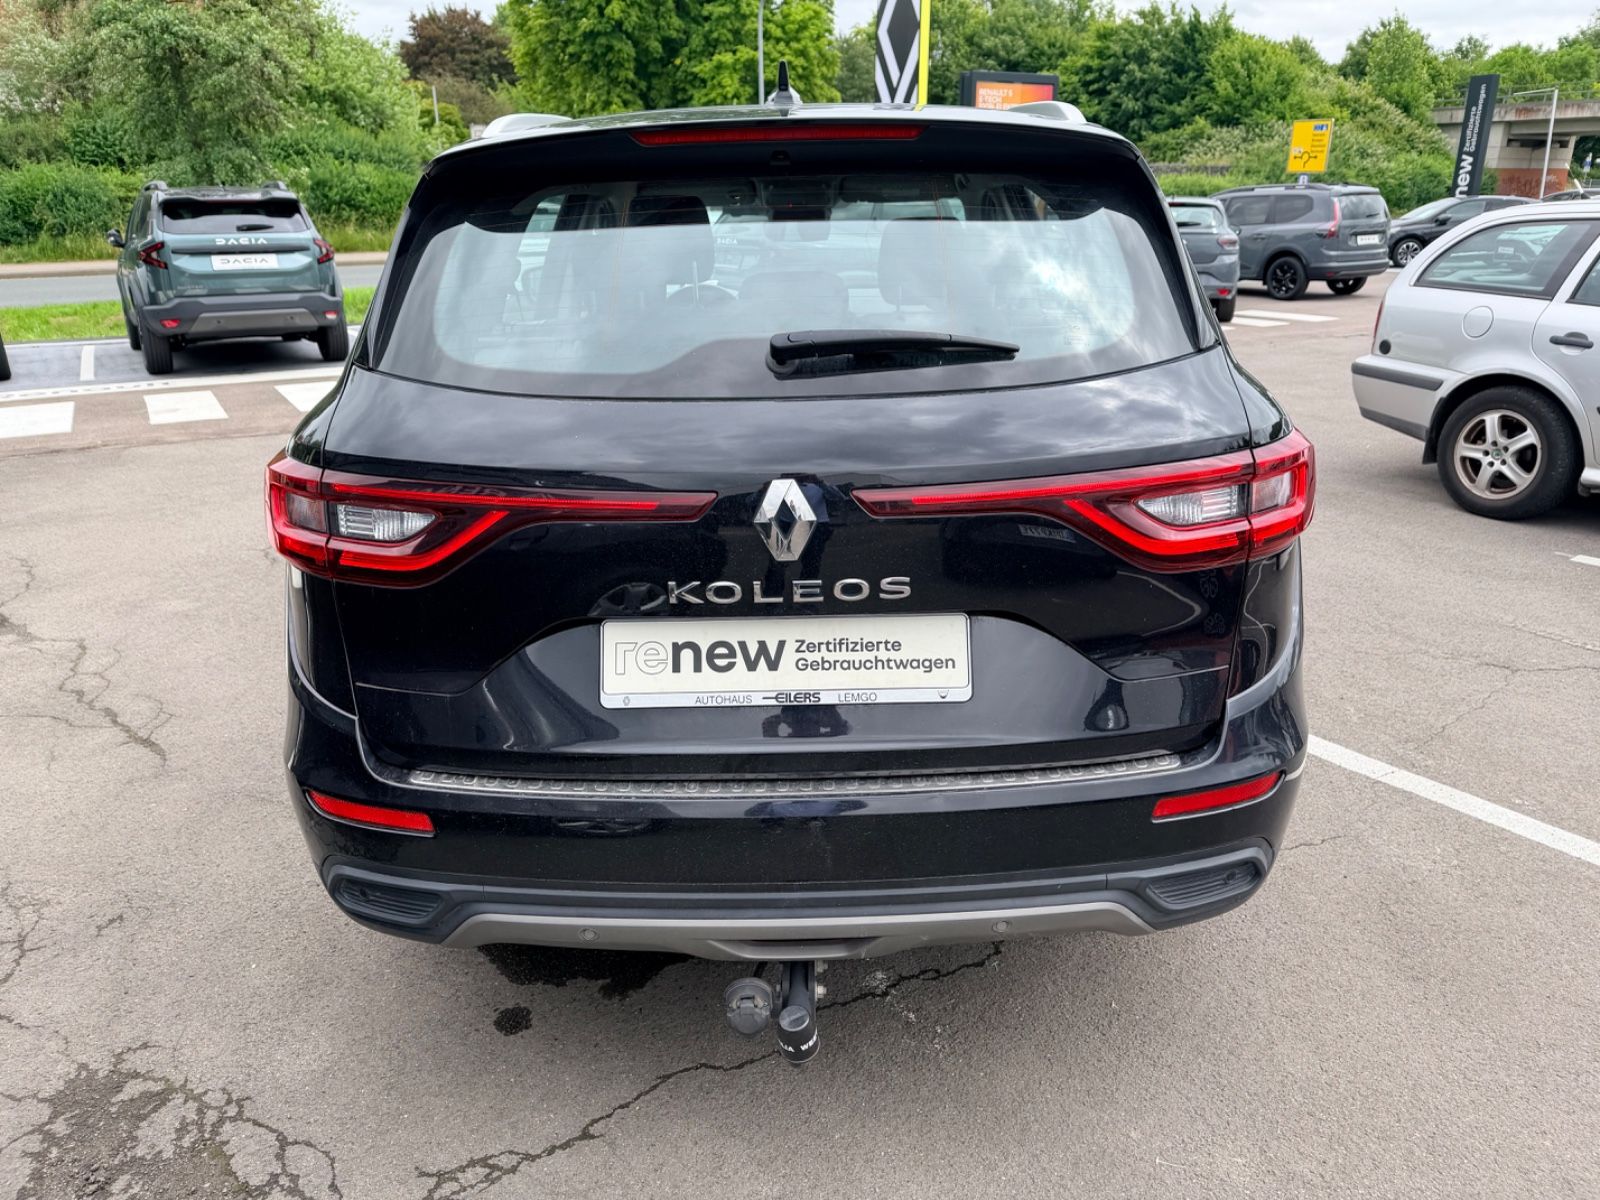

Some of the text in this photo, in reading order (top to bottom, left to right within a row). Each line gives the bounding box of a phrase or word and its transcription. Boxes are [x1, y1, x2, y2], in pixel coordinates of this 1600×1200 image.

[220, 257, 269, 265] DACIA
[667, 576, 912, 604] KOLEOS
[795, 637, 902, 653] Zertifizierte
[795, 654, 956, 674] Gebrauchtwagen
[695, 692, 878, 706] AUTOHAUS EILERS LEMGO
